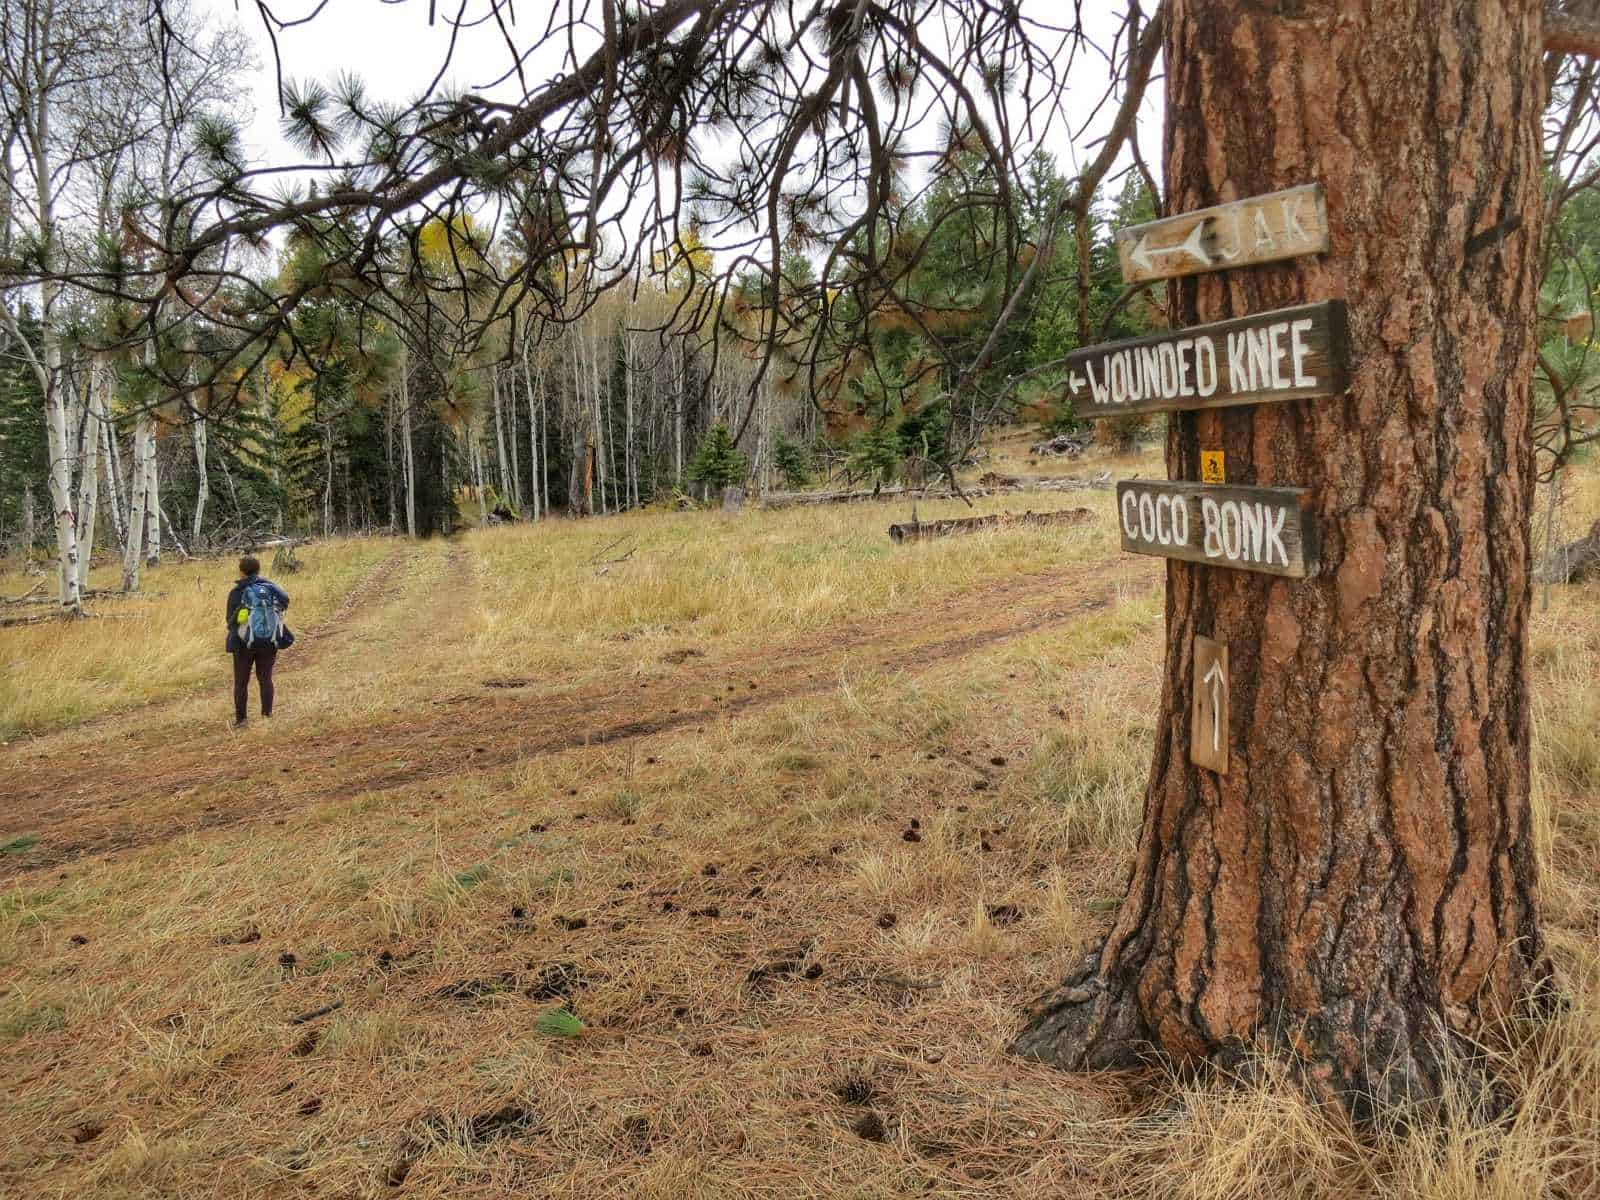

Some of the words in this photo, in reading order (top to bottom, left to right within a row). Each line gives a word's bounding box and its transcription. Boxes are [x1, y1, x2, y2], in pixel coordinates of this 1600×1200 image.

[1218, 198, 1309, 259] JAK
[1086, 335, 1217, 403] WOUNDED
[1227, 318, 1317, 394] KNEE
[1122, 490, 1188, 545] COCO
[1202, 498, 1288, 567] BONK
